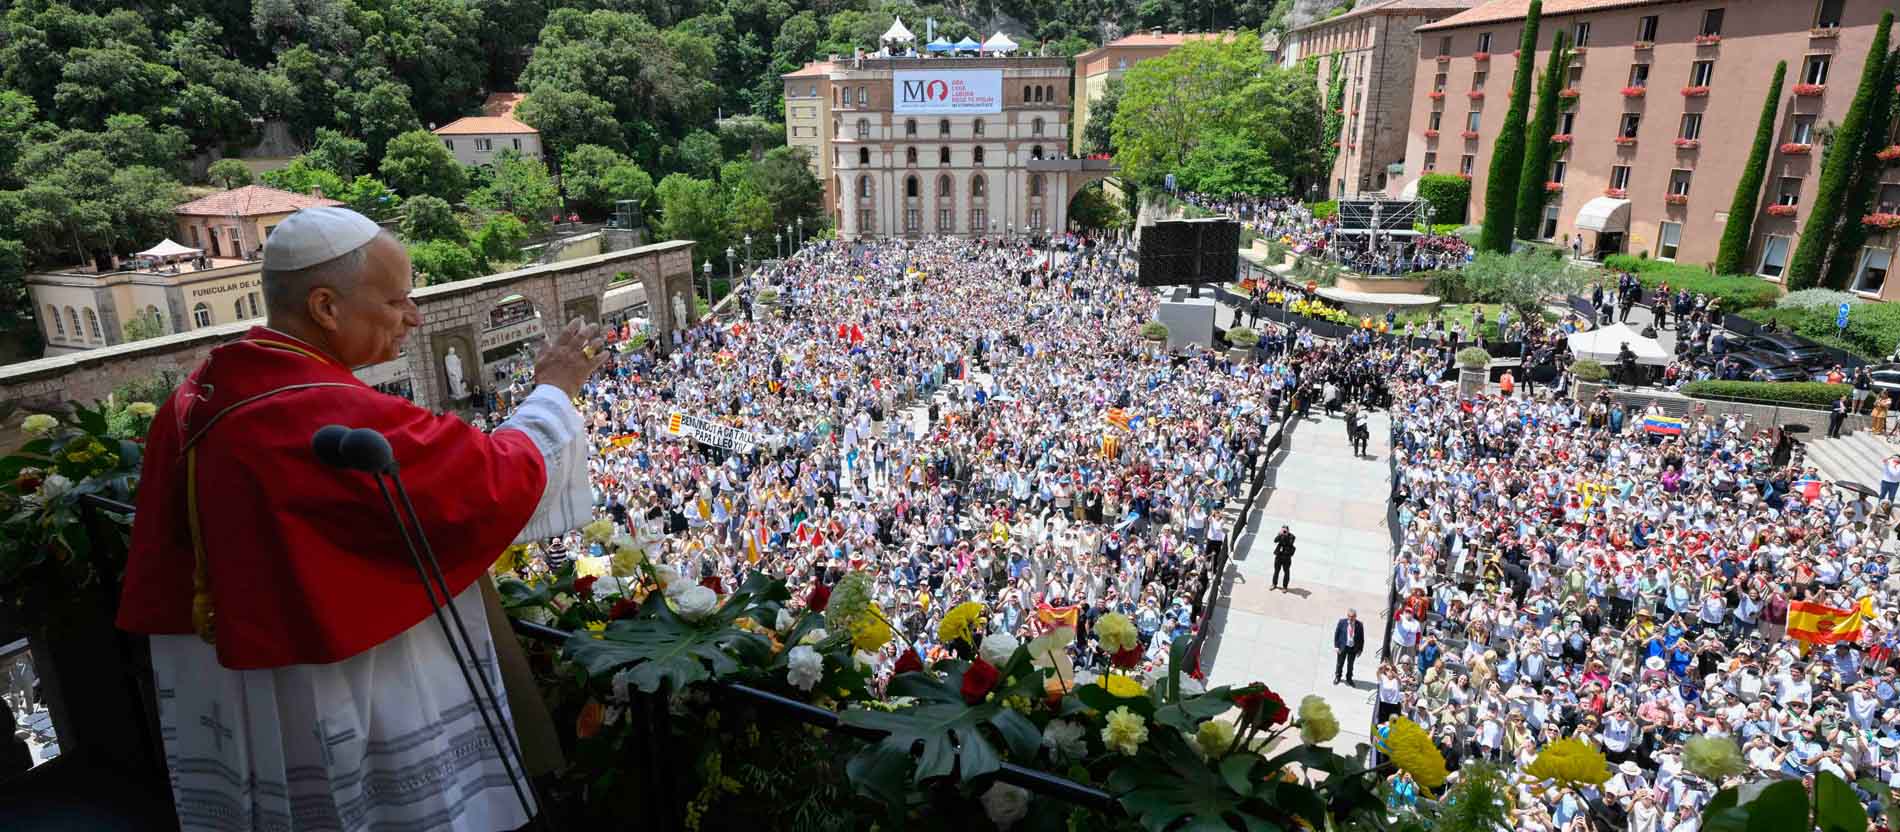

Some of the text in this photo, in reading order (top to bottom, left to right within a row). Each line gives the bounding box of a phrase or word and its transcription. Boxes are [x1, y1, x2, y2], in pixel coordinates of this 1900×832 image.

[192, 283, 237, 297] FUNICULAR
[240, 281, 250, 289] DE
[527, 323, 538, 333] de
[695, 429, 712, 444] PAPA
[717, 426, 723, 436] A
